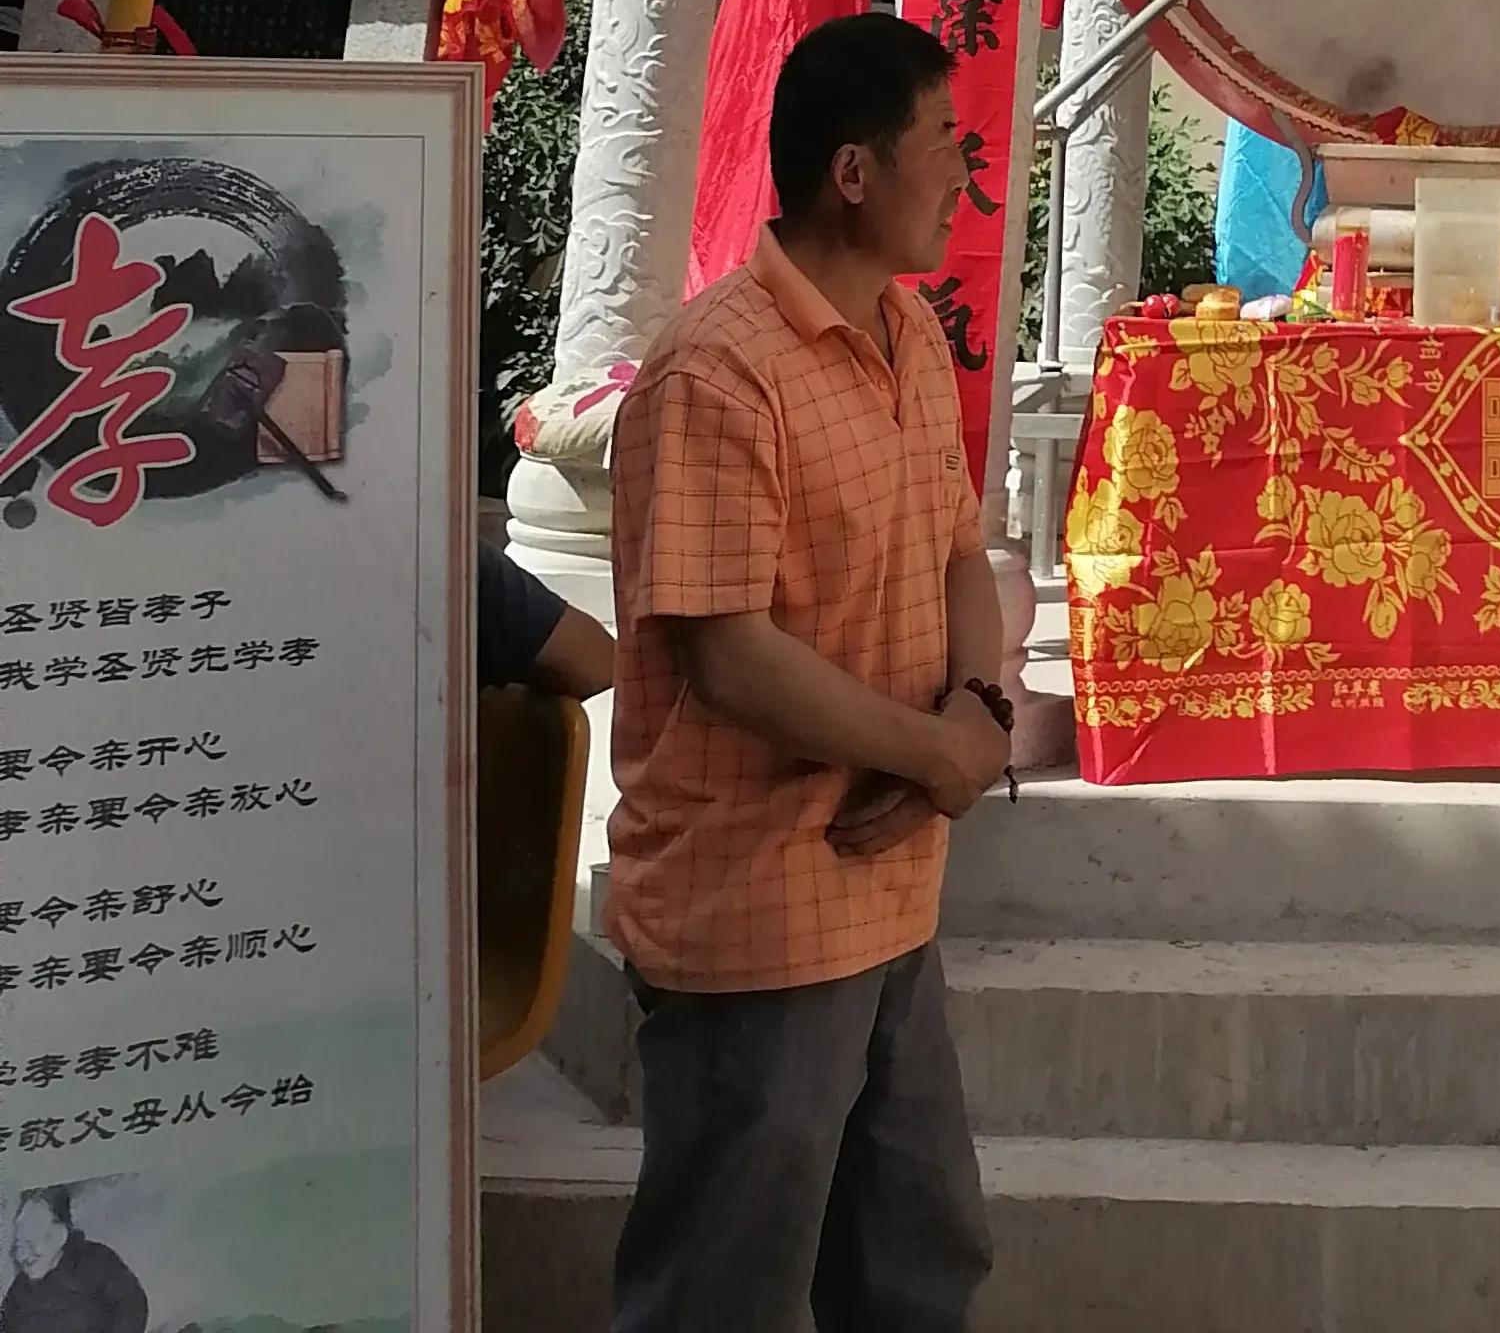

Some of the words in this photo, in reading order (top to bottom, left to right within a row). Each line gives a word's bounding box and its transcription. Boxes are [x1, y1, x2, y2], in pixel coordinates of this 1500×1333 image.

[0, 213, 194, 527] 孝
[0, 590, 231, 633] 圣贤皆孝子
[0, 637, 320, 691] 我学圣贤先学孝
[0, 732, 227, 781] 要令亲开心
[0, 1073, 315, 1152] 敬父母从今始
